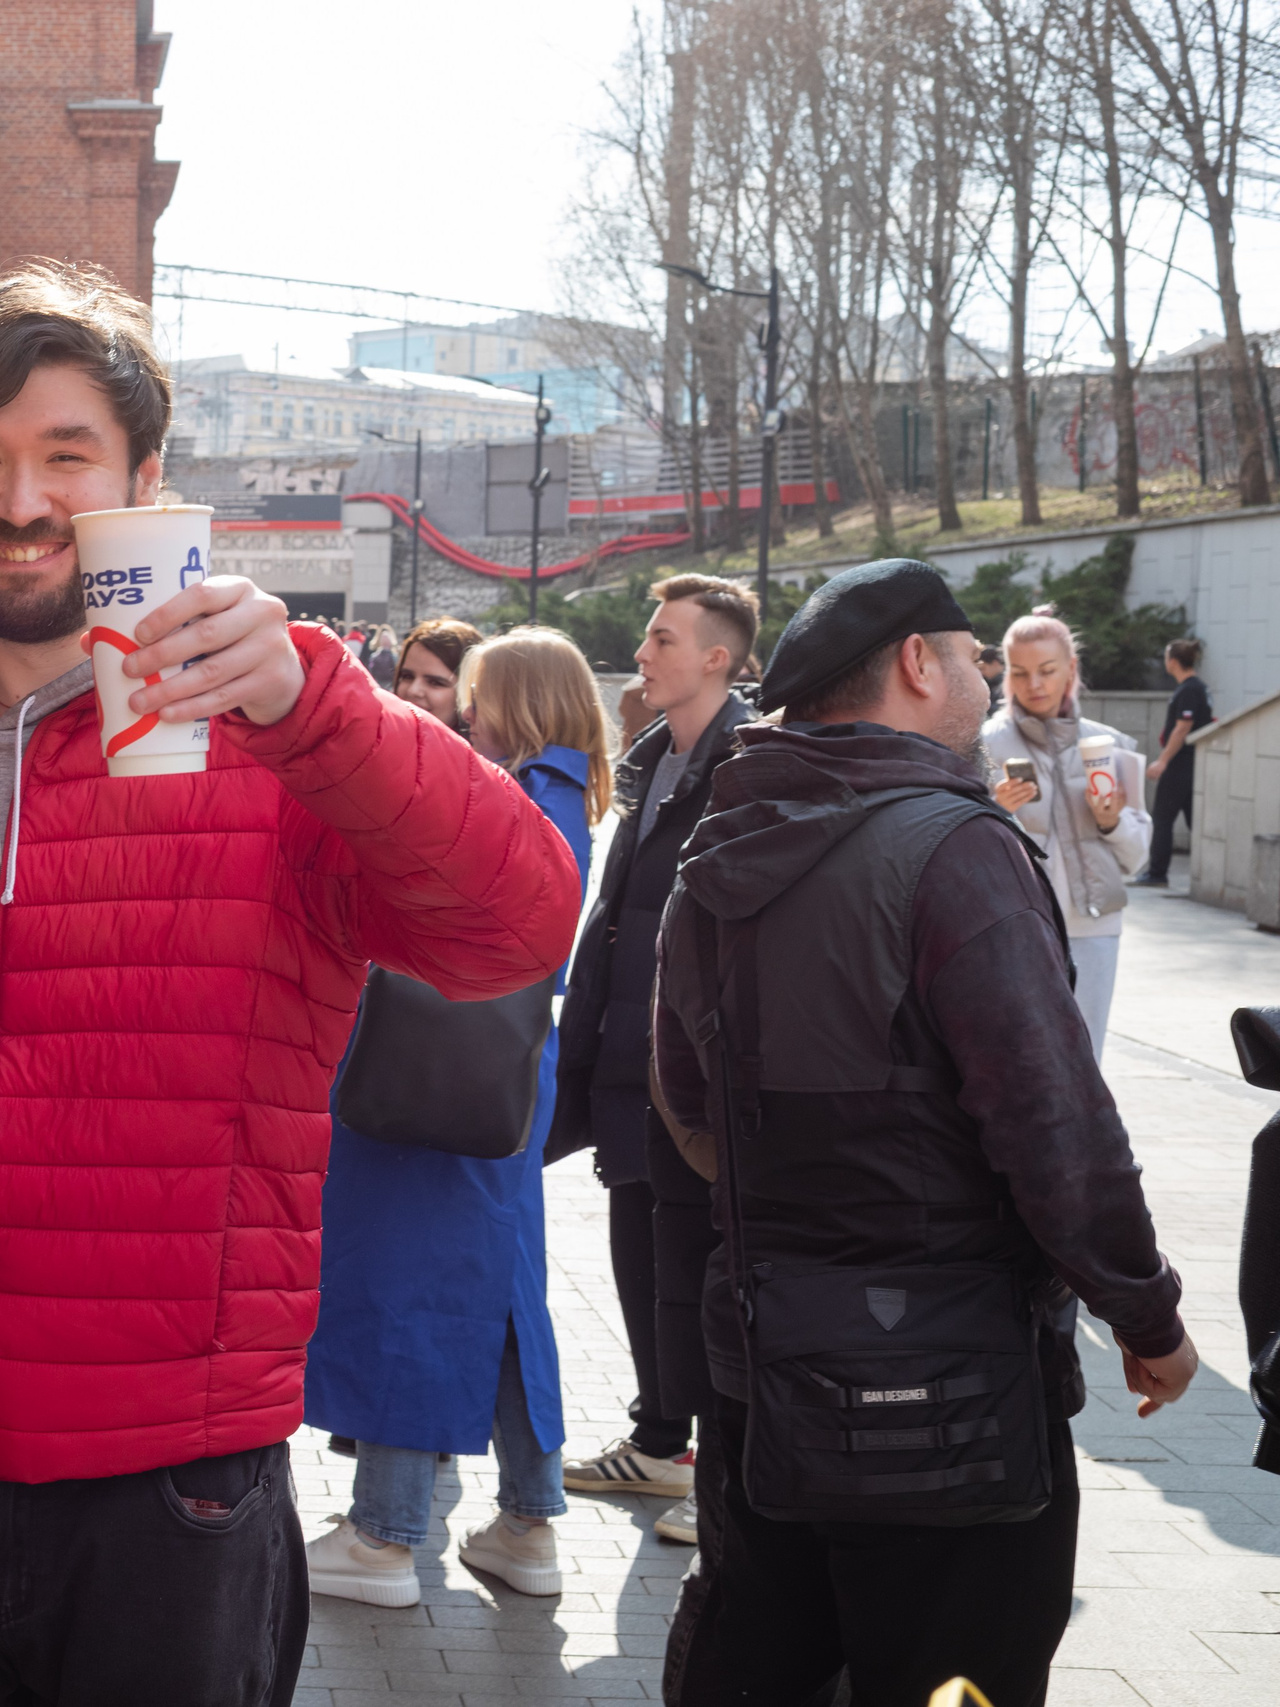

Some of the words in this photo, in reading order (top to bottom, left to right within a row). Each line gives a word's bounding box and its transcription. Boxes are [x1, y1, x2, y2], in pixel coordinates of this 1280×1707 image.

[81, 566, 153, 590] ОФЕ
[85, 587, 144, 609] АУЗ
[884, 1388, 928, 1401] DESIGNER
